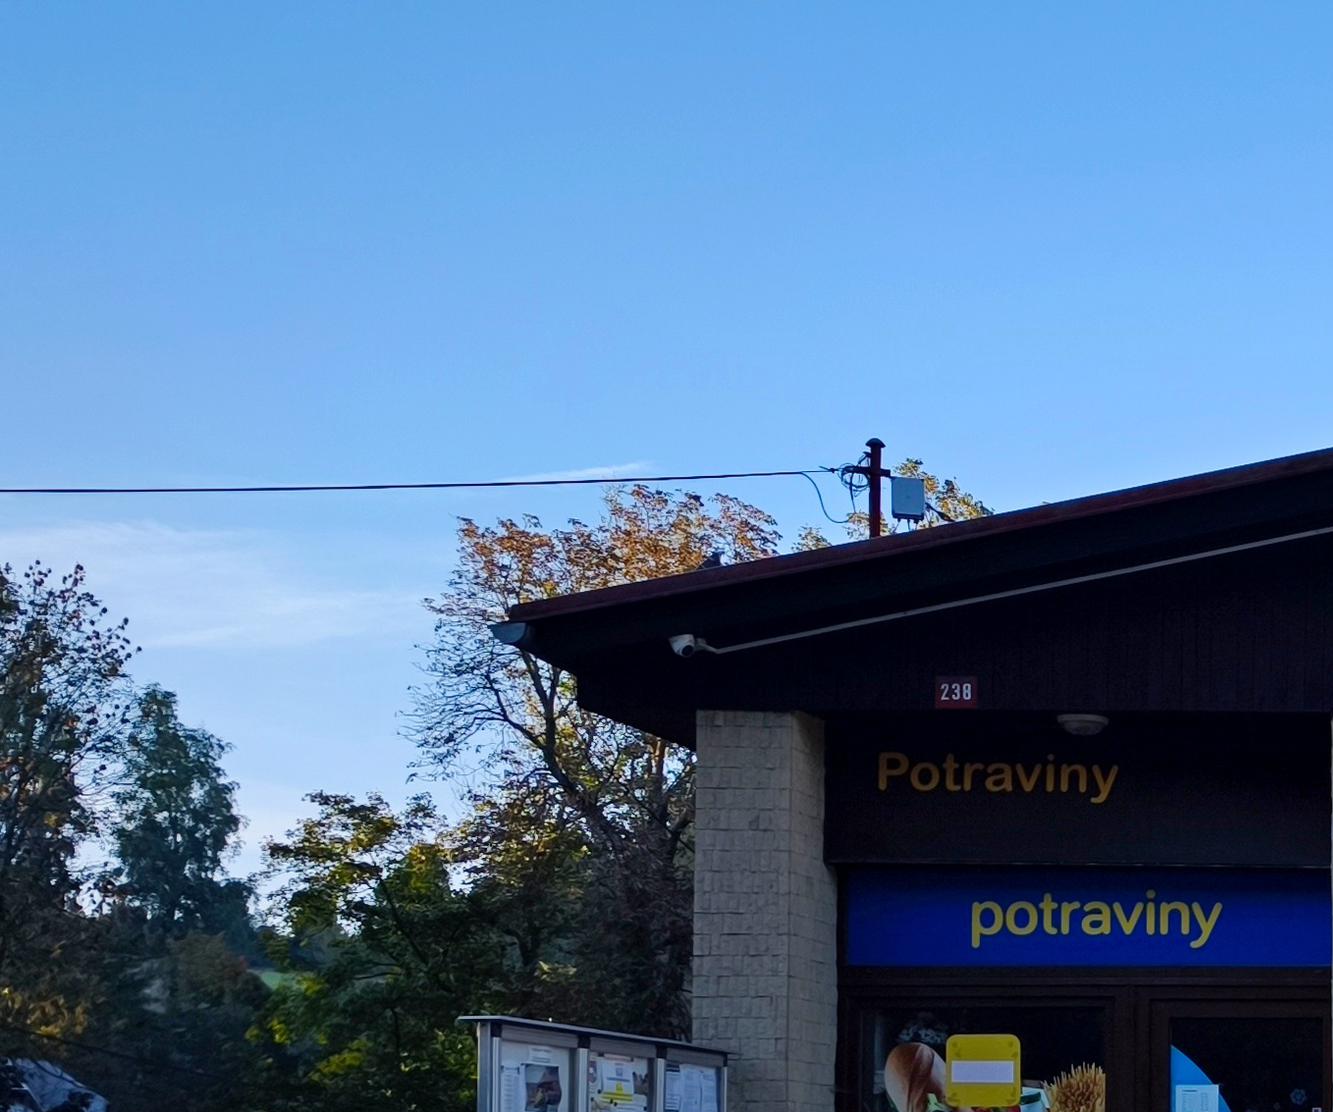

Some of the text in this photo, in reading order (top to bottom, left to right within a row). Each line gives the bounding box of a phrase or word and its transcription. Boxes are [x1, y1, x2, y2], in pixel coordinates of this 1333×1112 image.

[940, 683, 972, 700] 238
[877, 752, 1119, 804] Potraviny
[970, 890, 1223, 949] potraviny
